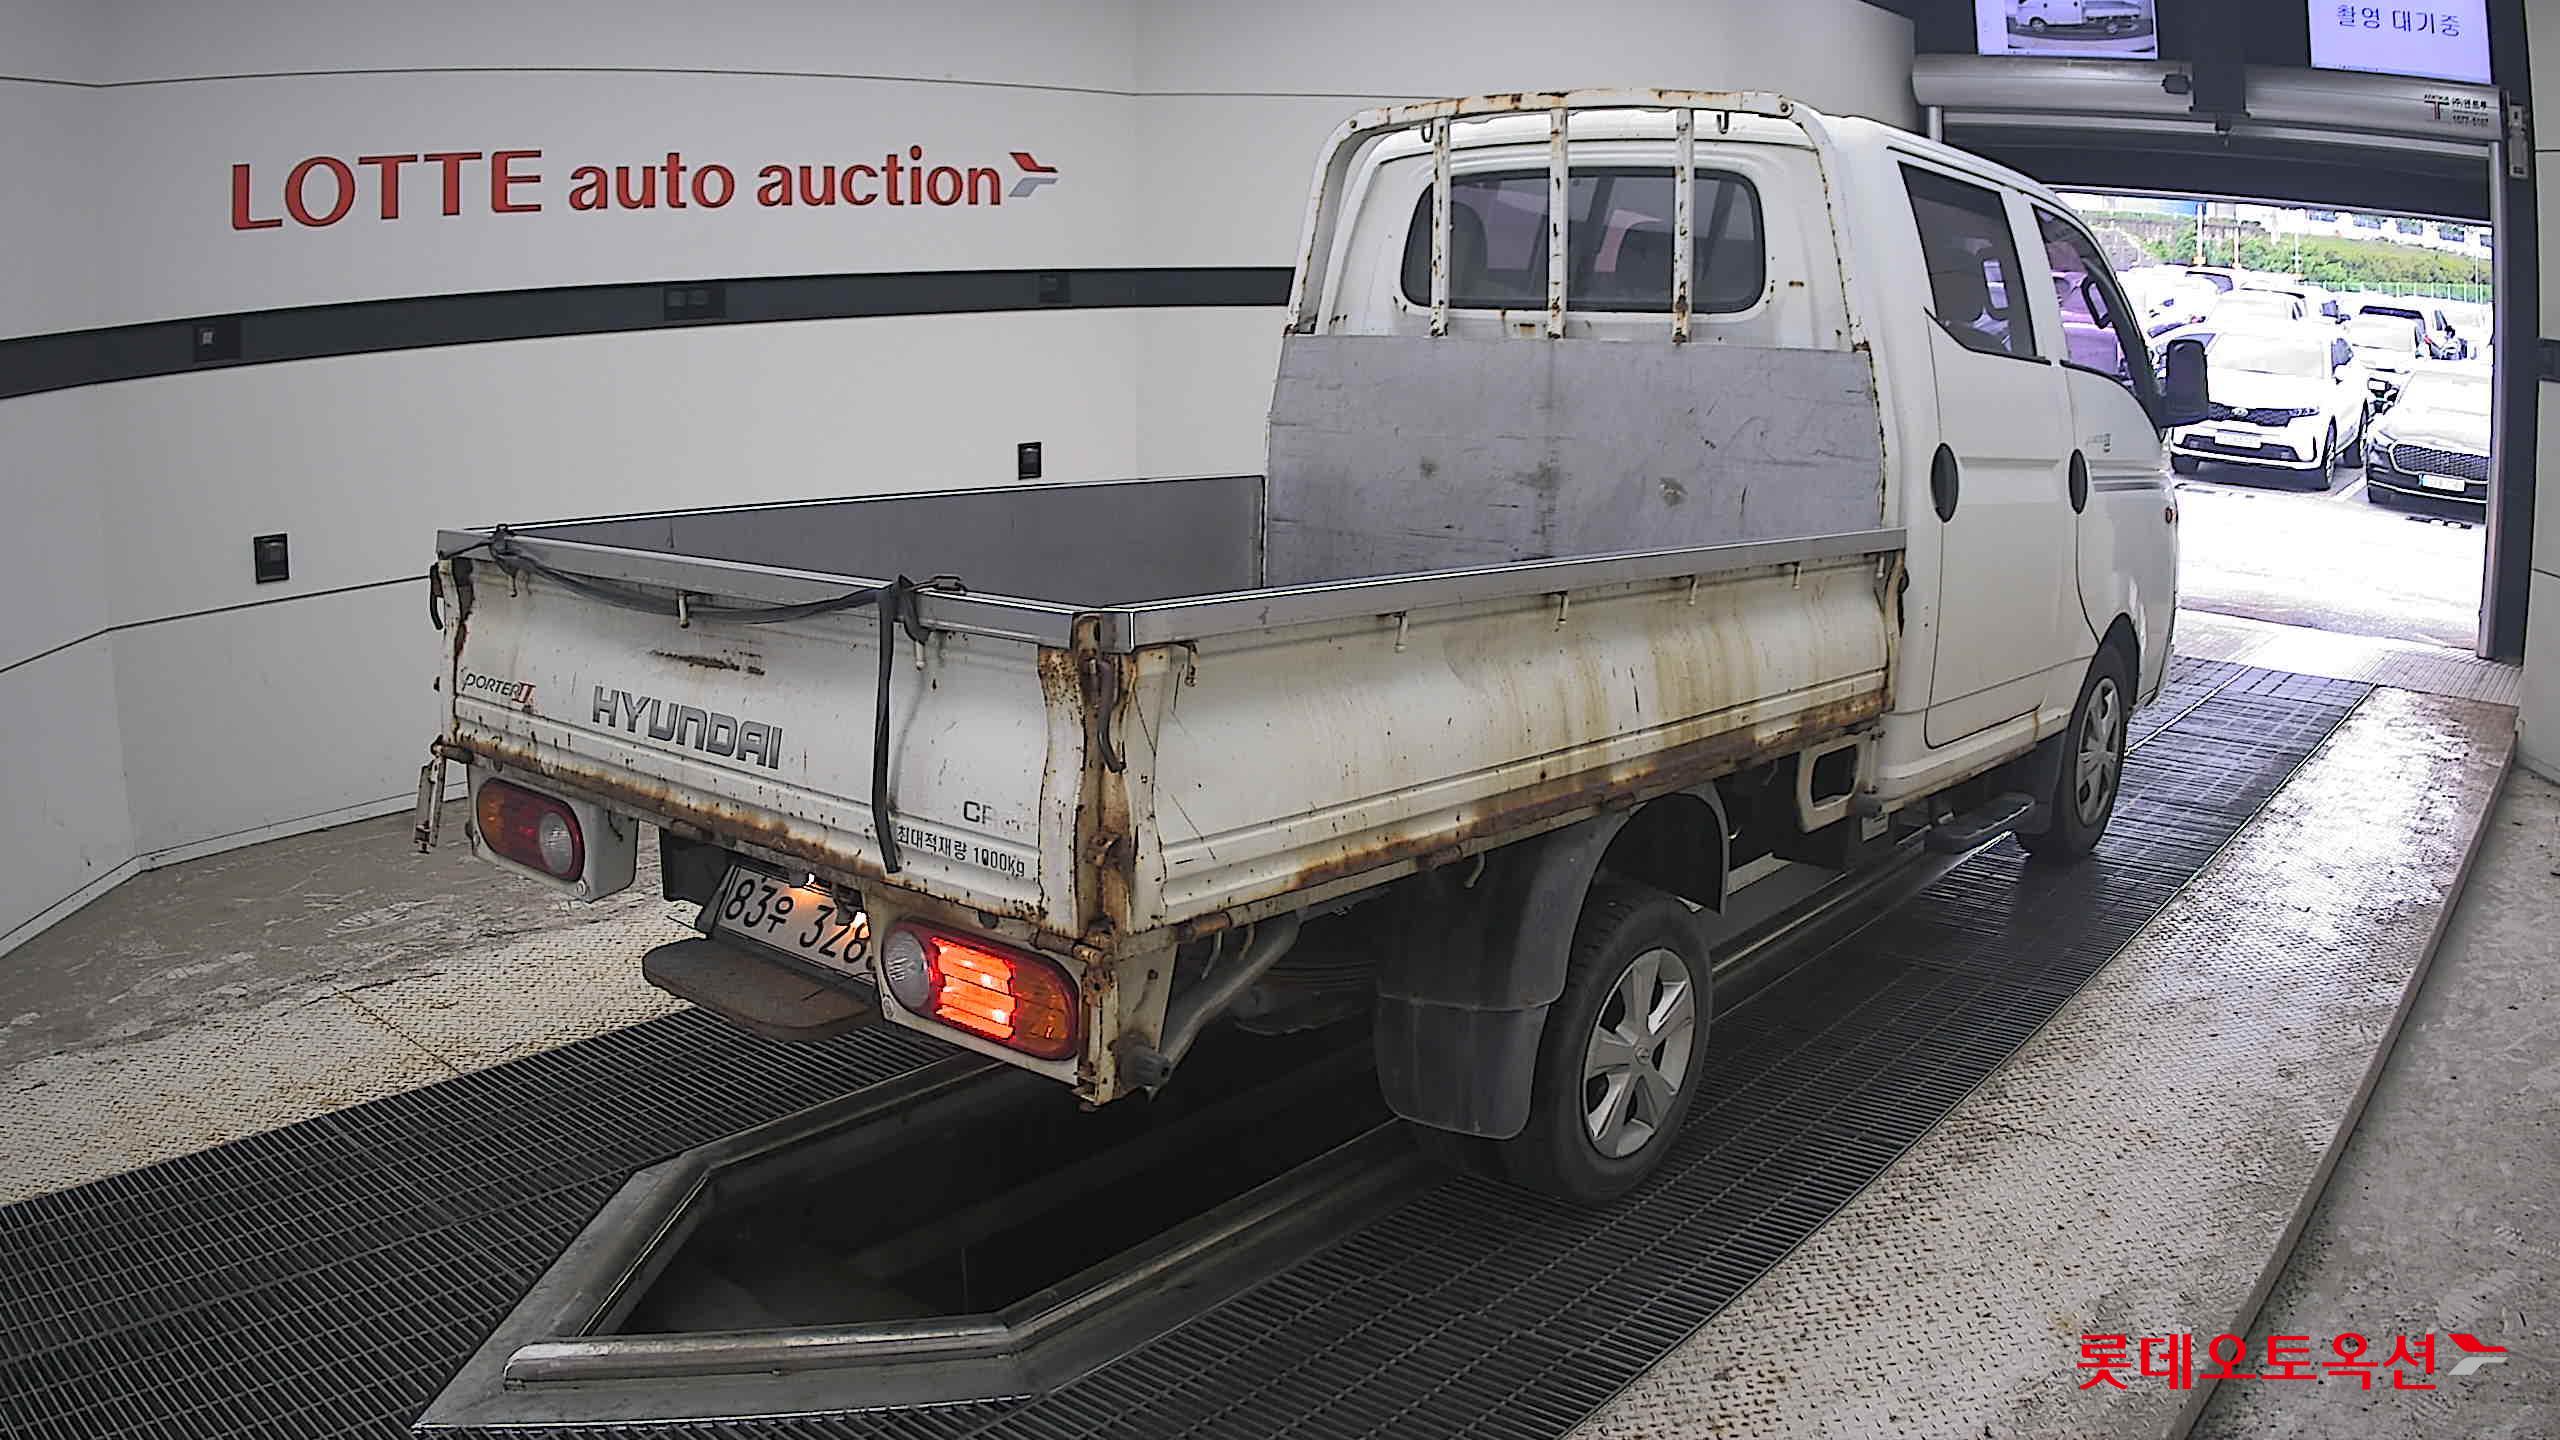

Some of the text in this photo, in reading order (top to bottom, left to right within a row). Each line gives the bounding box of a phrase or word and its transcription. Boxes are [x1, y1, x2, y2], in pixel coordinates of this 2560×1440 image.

[2338, 4, 2460, 37] 촬영 대기중
[231, 145, 1002, 231] LOTTE auto auction
[592, 684, 784, 770] HYUNDAI
[896, 824, 968, 861] 최대적재량
[725, 878, 794, 933] 83우
